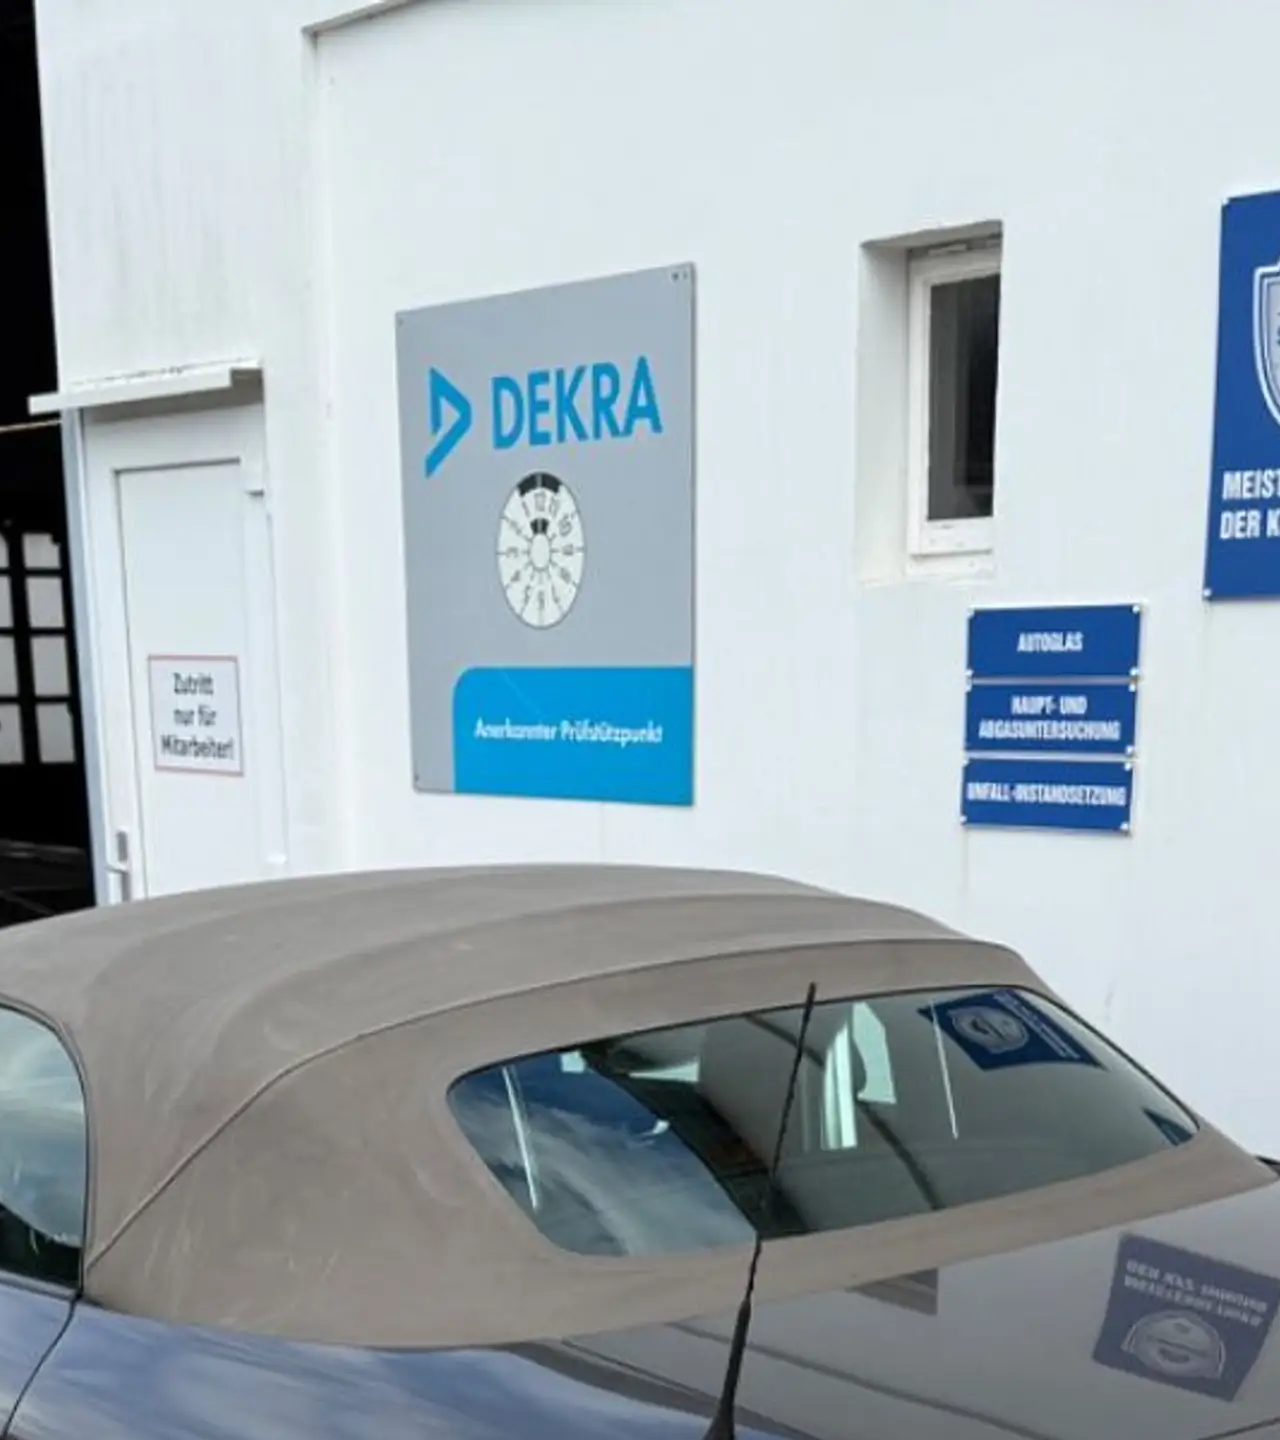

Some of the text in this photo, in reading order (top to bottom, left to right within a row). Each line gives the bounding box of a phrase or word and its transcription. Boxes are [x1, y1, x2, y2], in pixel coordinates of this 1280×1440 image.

[492, 355, 663, 450] DEKRA
[1219, 511, 1260, 540] DER
[1017, 631, 1084, 652] AUTOGLAS
[1060, 696, 1088, 715] UND
[474, 716, 664, 748] Anerkannter Prüfstützpunkt
